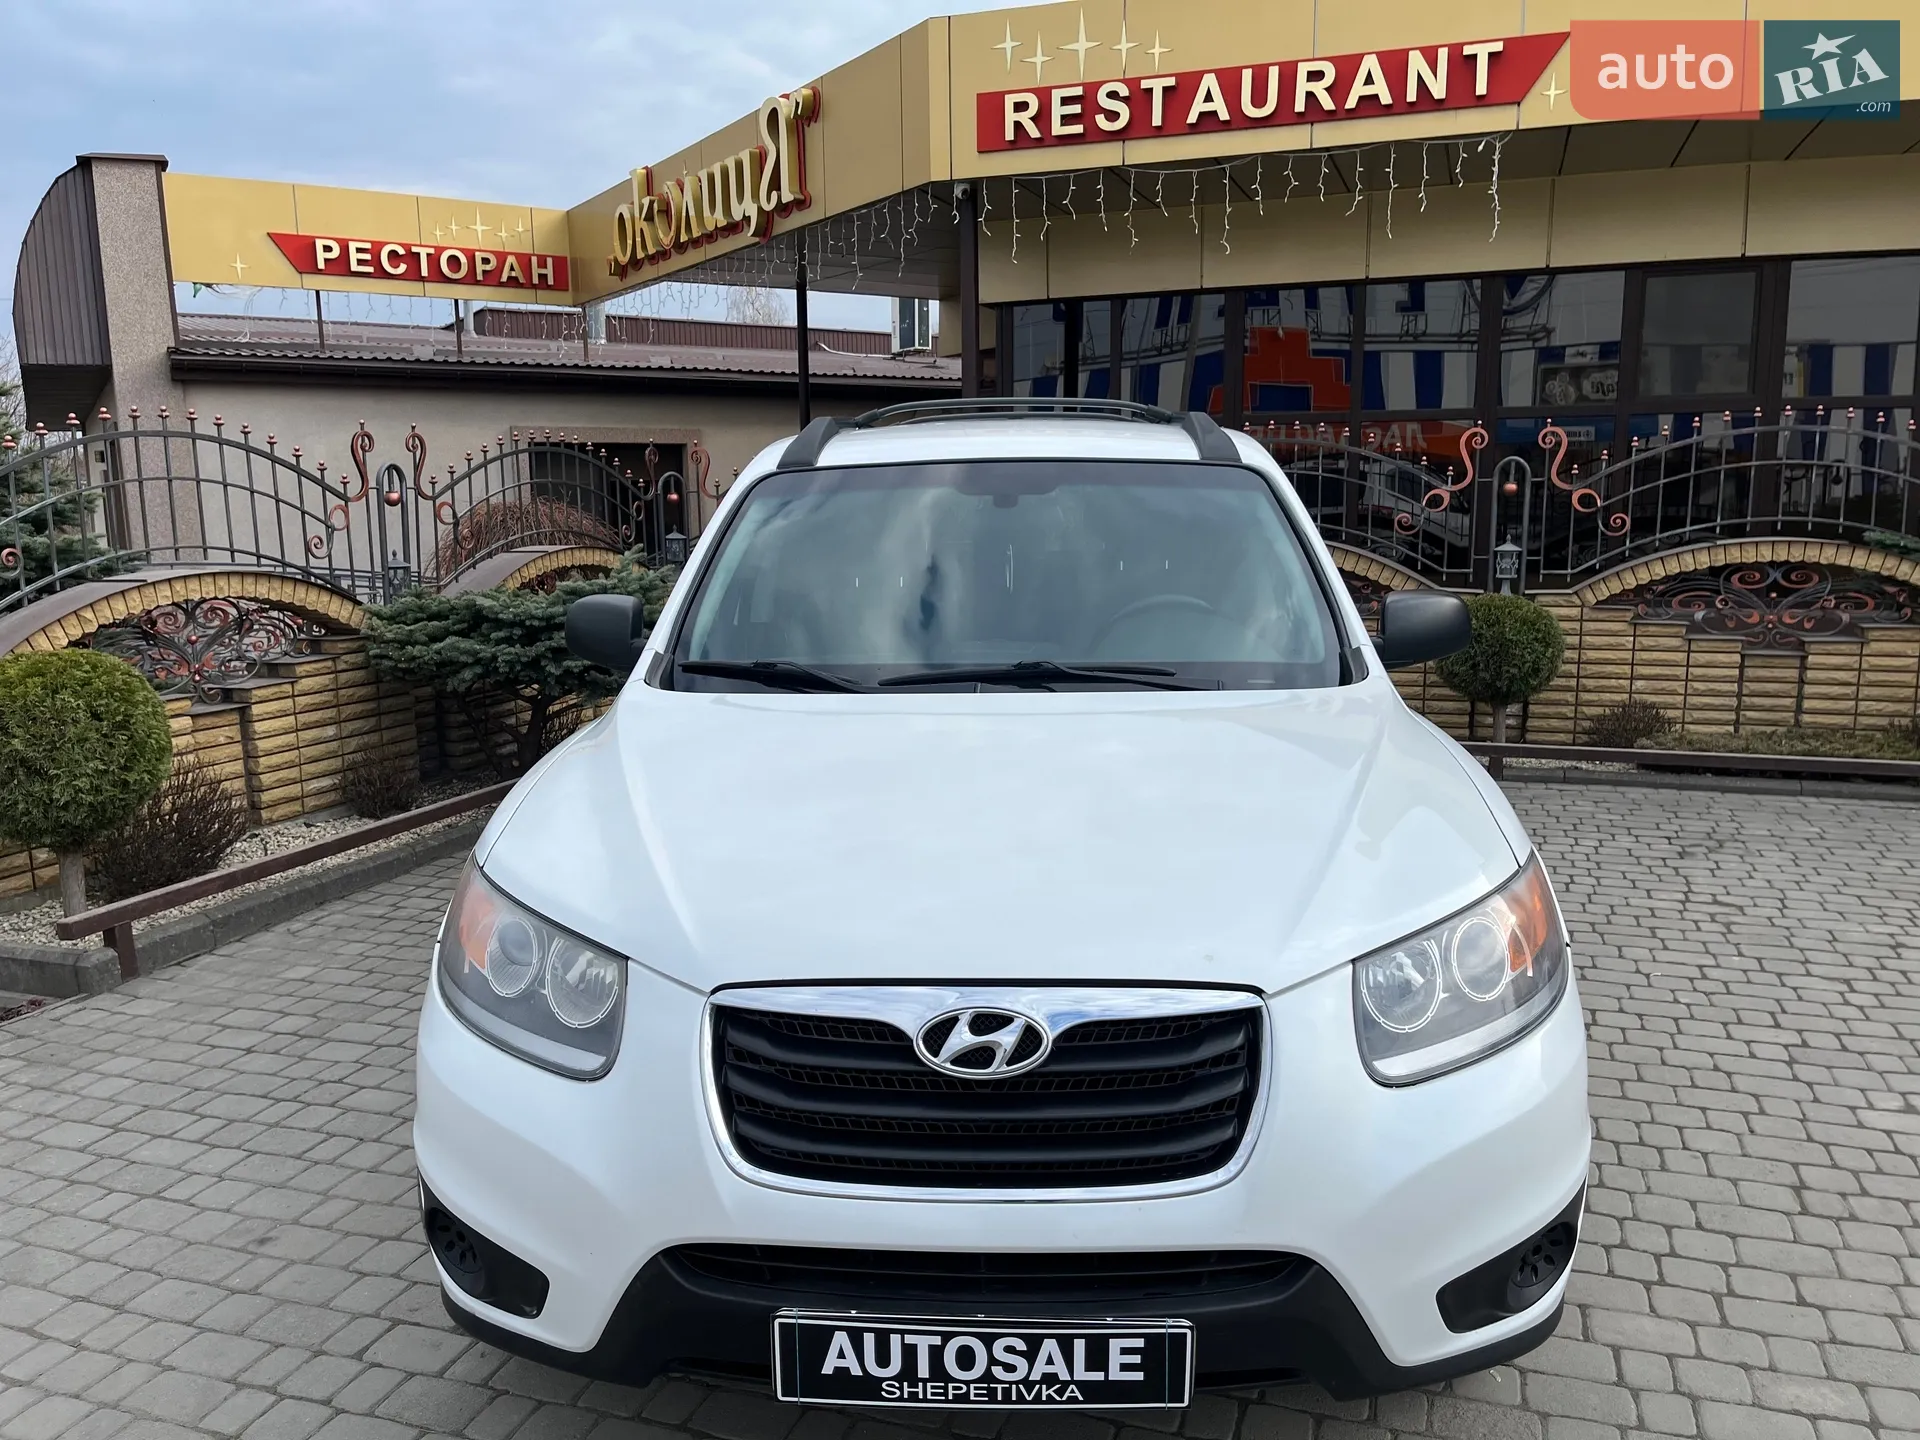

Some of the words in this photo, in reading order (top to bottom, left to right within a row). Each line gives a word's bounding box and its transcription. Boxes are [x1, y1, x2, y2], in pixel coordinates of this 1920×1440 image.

[1003, 40, 1506, 143] RESTAURANT
[314, 237, 556, 287] РЕСТОРАН
[821, 1330, 1146, 1381] AUTOSALE
[880, 1380, 1085, 1401] SHEPETIVKA
